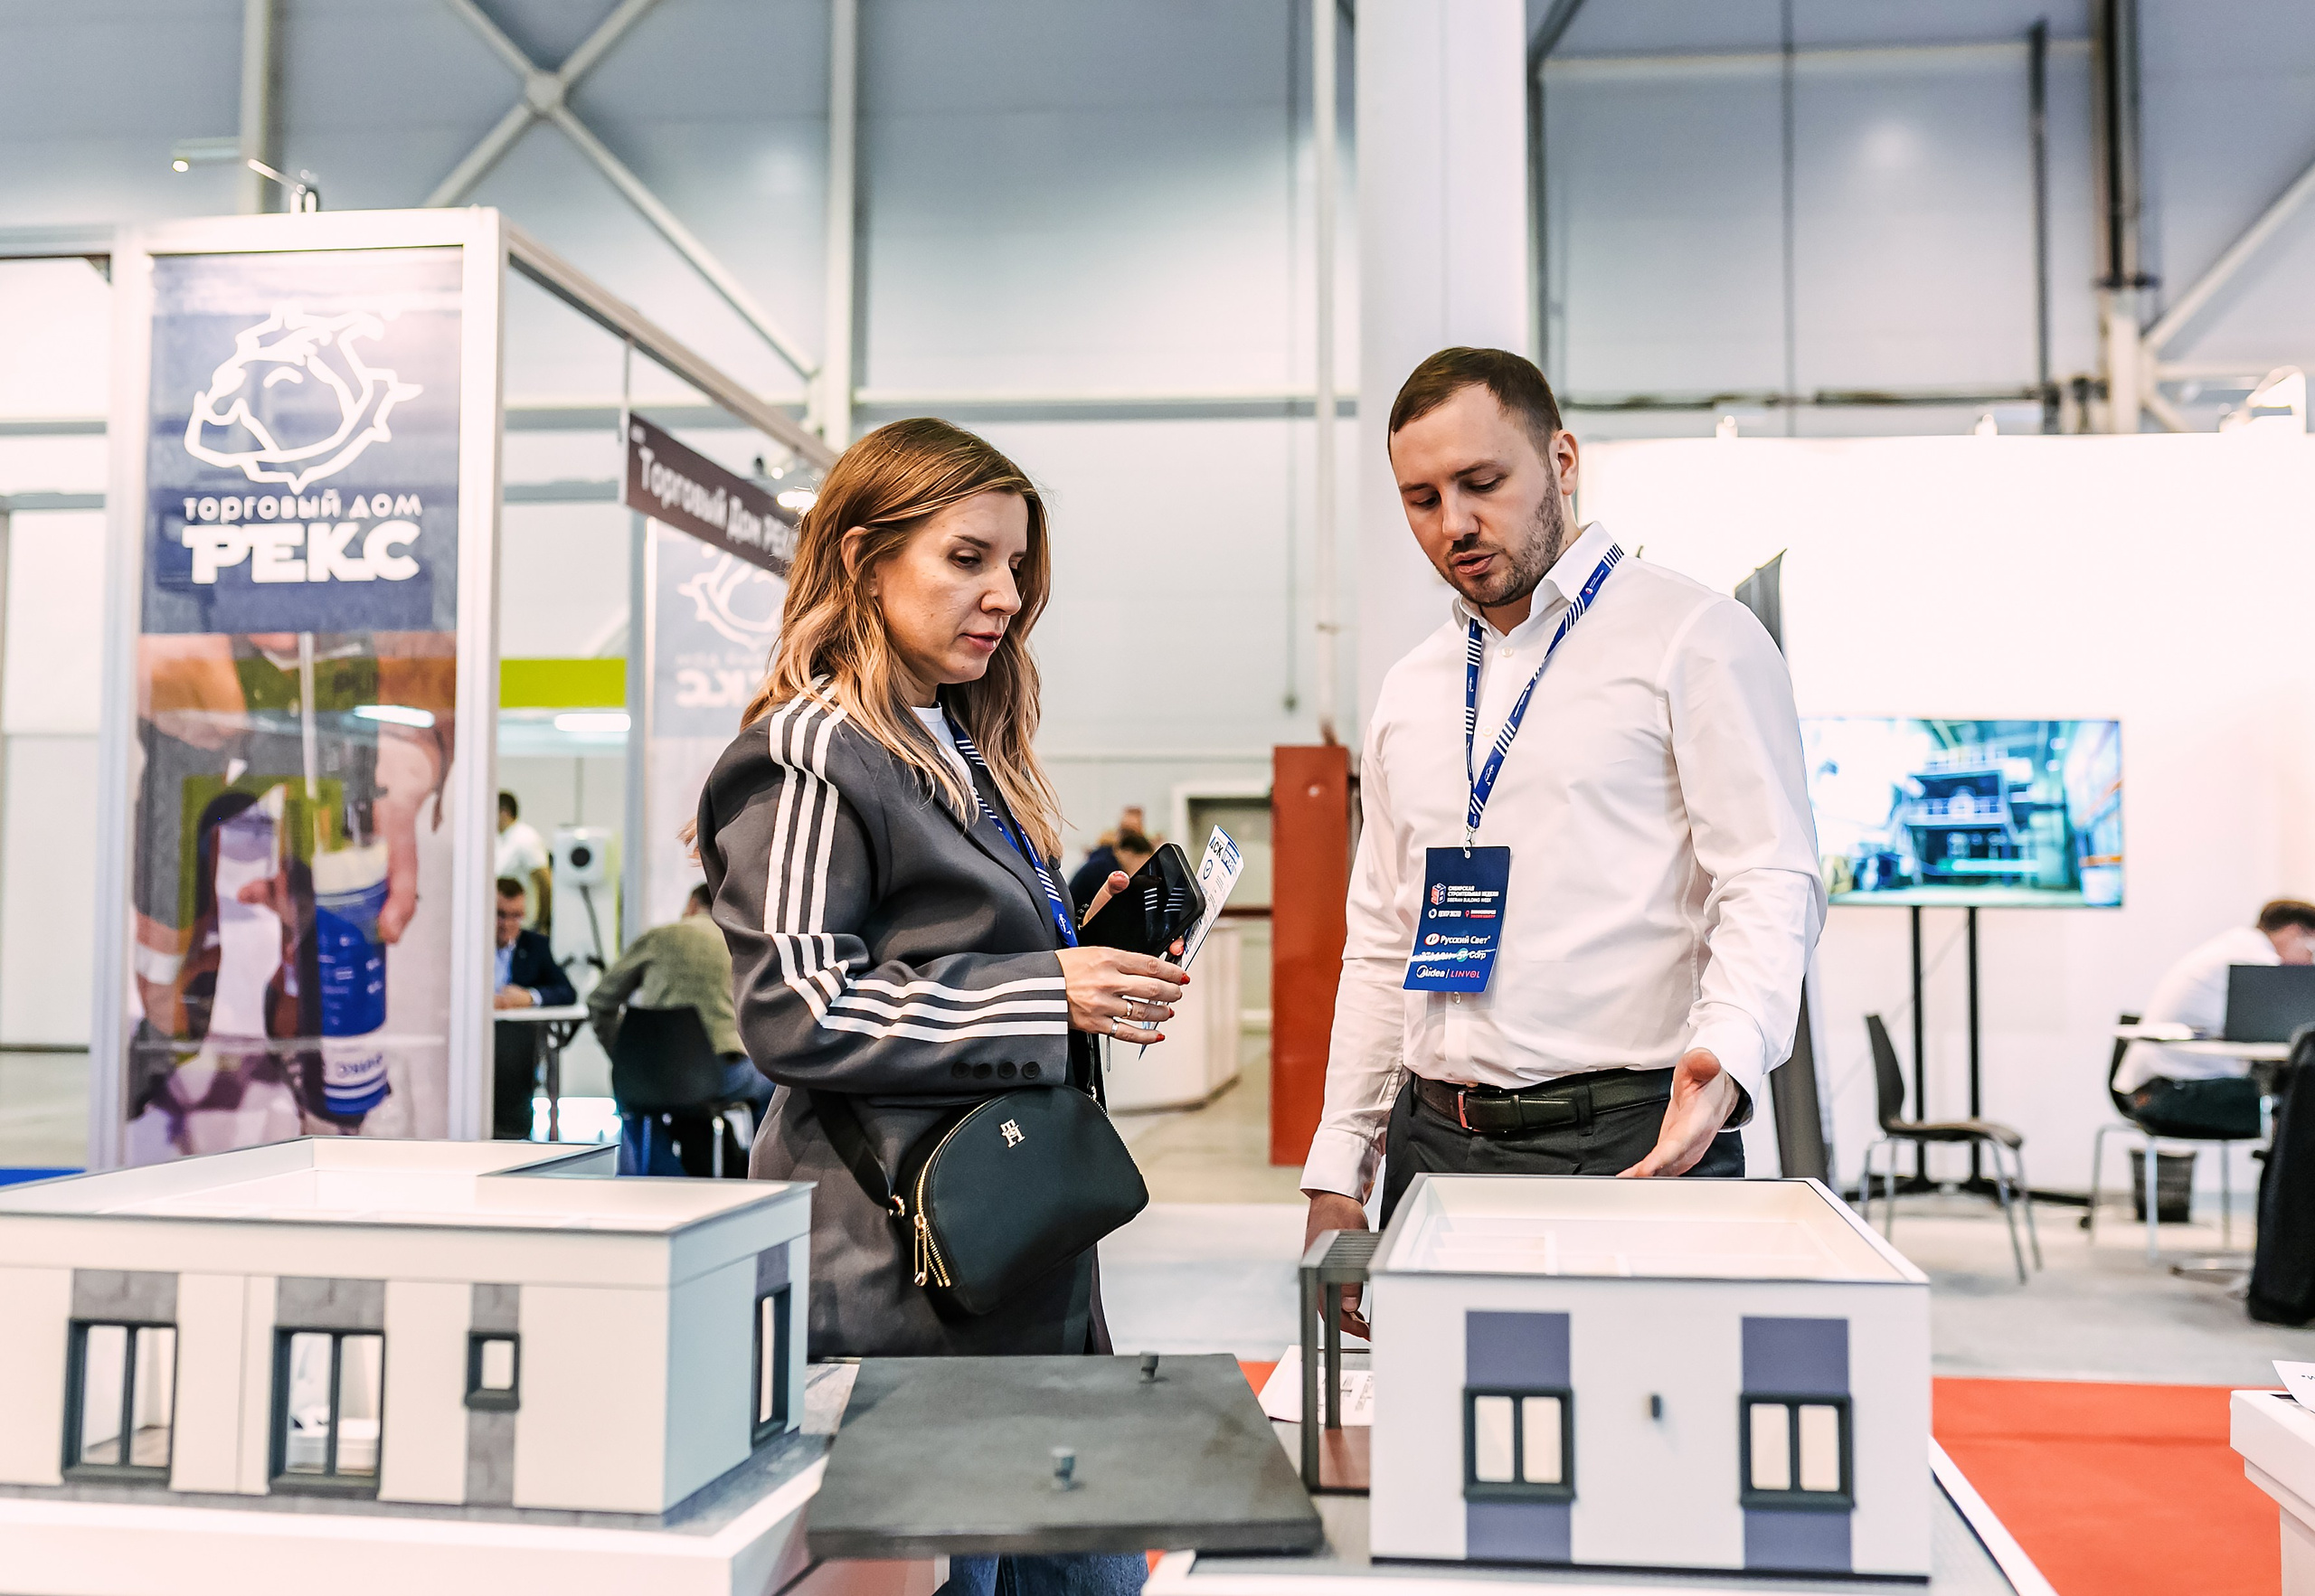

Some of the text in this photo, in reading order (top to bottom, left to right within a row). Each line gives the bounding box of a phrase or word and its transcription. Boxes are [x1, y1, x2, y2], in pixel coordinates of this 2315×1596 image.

[182, 520, 421, 584] РЕКС
[1441, 935, 1488, 945] Русский Свет
[1416, 965, 1480, 978] Midea LINVOL
